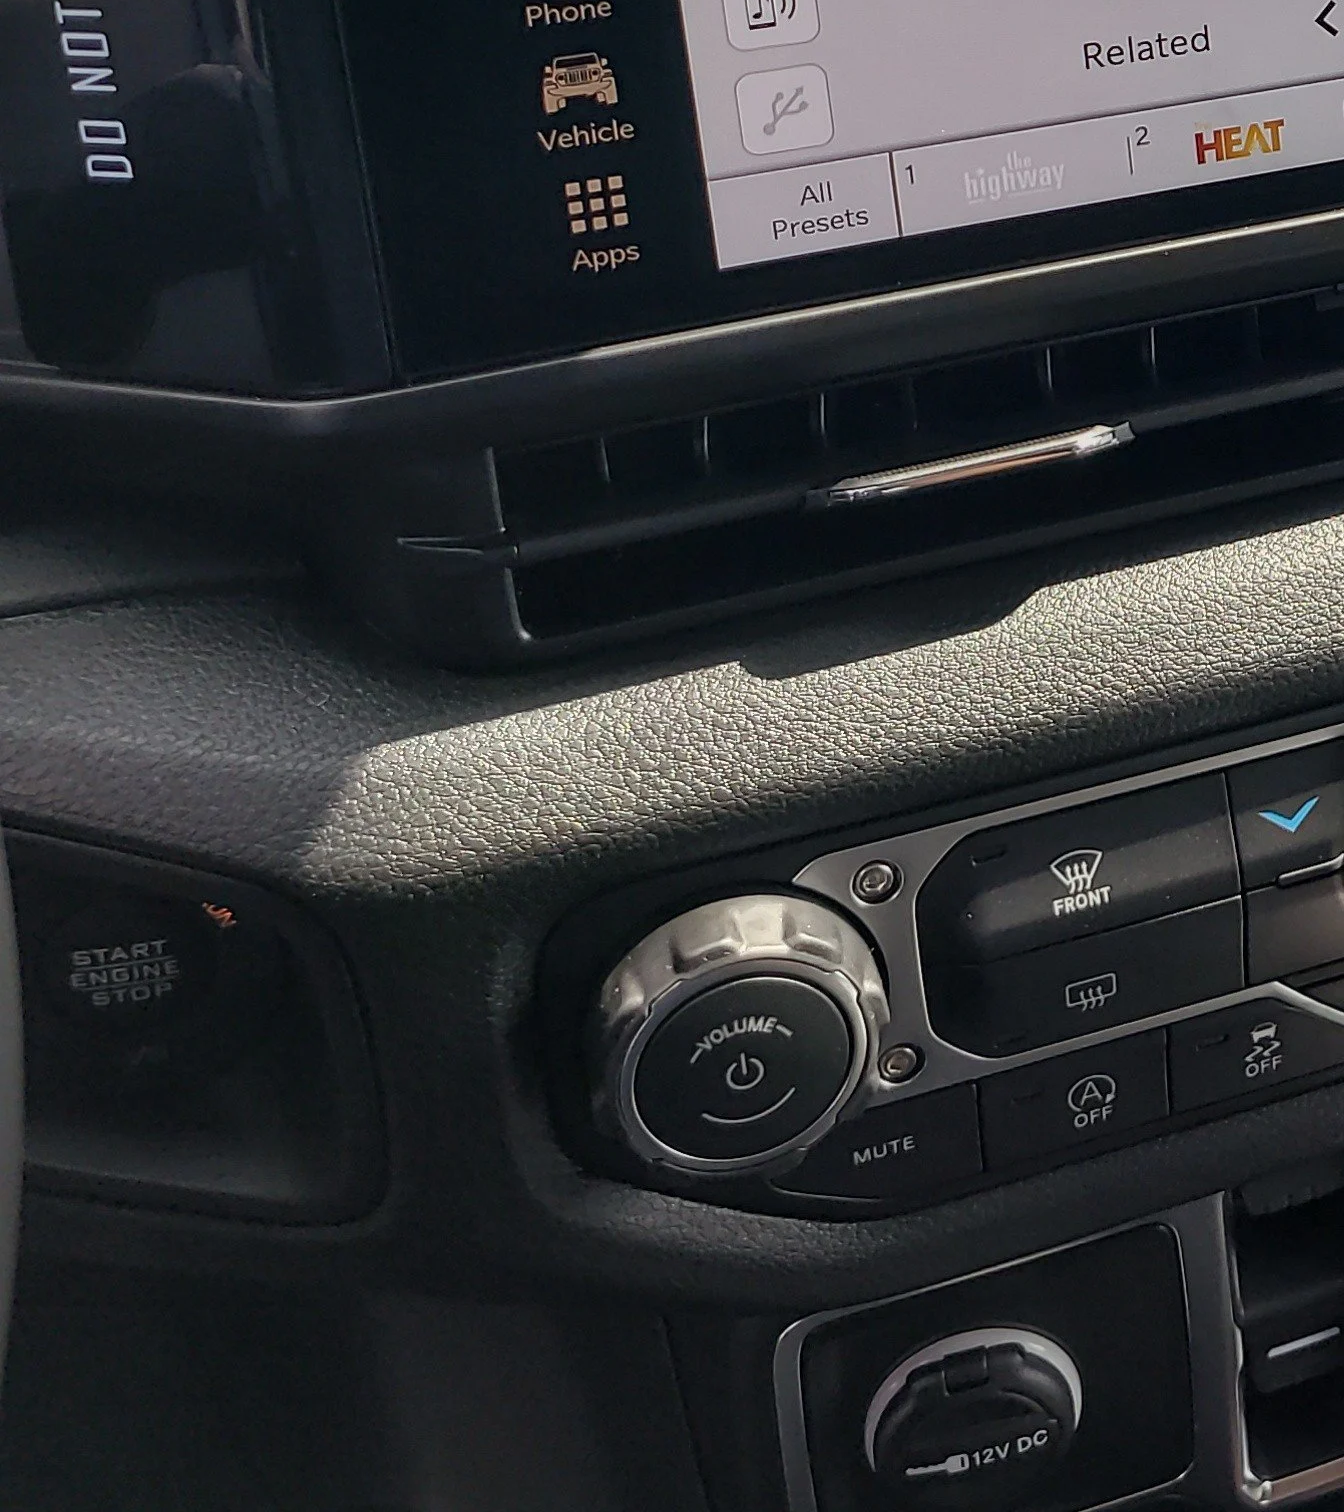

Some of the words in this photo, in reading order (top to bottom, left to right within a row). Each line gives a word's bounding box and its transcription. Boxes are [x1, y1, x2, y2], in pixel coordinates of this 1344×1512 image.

[55, 1, 117, 92] NOT
[1083, 26, 1211, 70] Related
[79, 118, 135, 181] DO
[537, 120, 634, 151] Vehicle
[1135, 126, 1151, 146] 2
[1194, 118, 1285, 164] HEAT
[1007, 150, 1032, 170] the
[905, 166, 915, 185] 1
[964, 164, 1064, 201] highway
[800, 181, 833, 207] All
[772, 208, 869, 240] Presets
[572, 243, 640, 273] Apps
[201, 900, 239, 929] UN
[1052, 886, 1111, 916] FRONT
[72, 938, 168, 966] START
[70, 960, 180, 987] ENGINE
[92, 982, 173, 1006] STOP
[697, 1016, 777, 1050] VOLUME
[1245, 1056, 1283, 1078] OFF
[1074, 1106, 1114, 1128] OFF
[853, 1135, 916, 1164] MUTE
[973, 1443, 1011, 1467] 12V
[1017, 1428, 1049, 1454] DC
